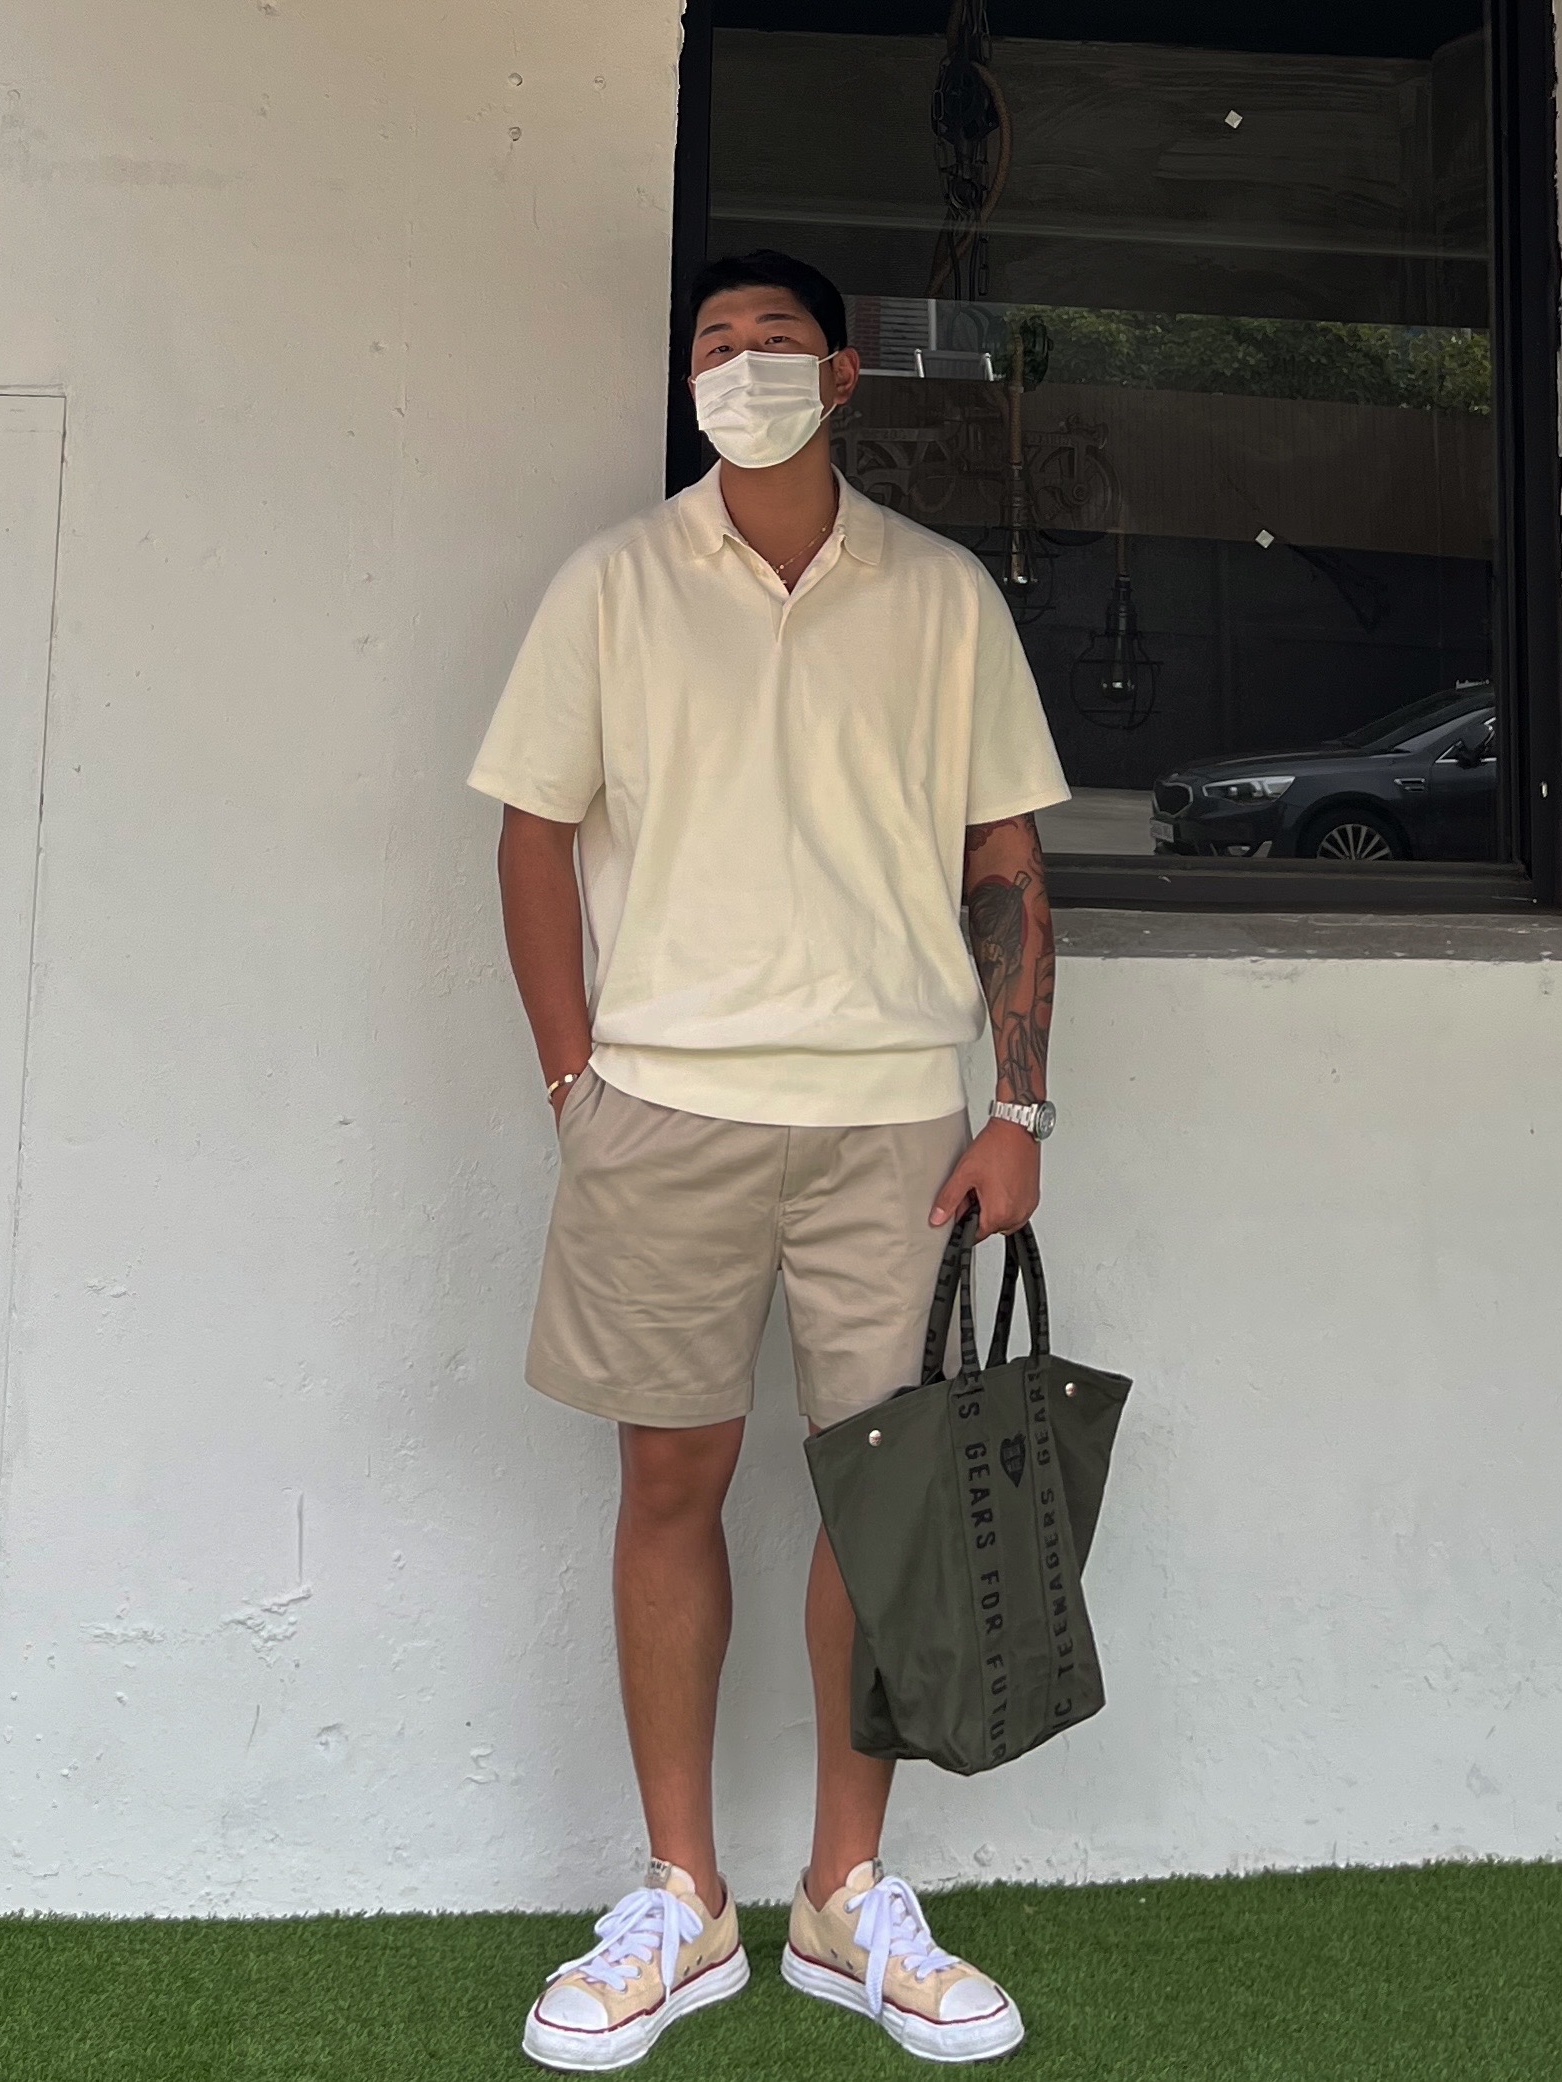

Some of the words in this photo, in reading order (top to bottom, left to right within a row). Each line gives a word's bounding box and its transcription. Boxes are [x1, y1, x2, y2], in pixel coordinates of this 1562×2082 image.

[964, 1441, 996, 1549] GEARS
[980, 1569, 1004, 1635] FOR
[1040, 1487, 1075, 1678] TEENAGERS
